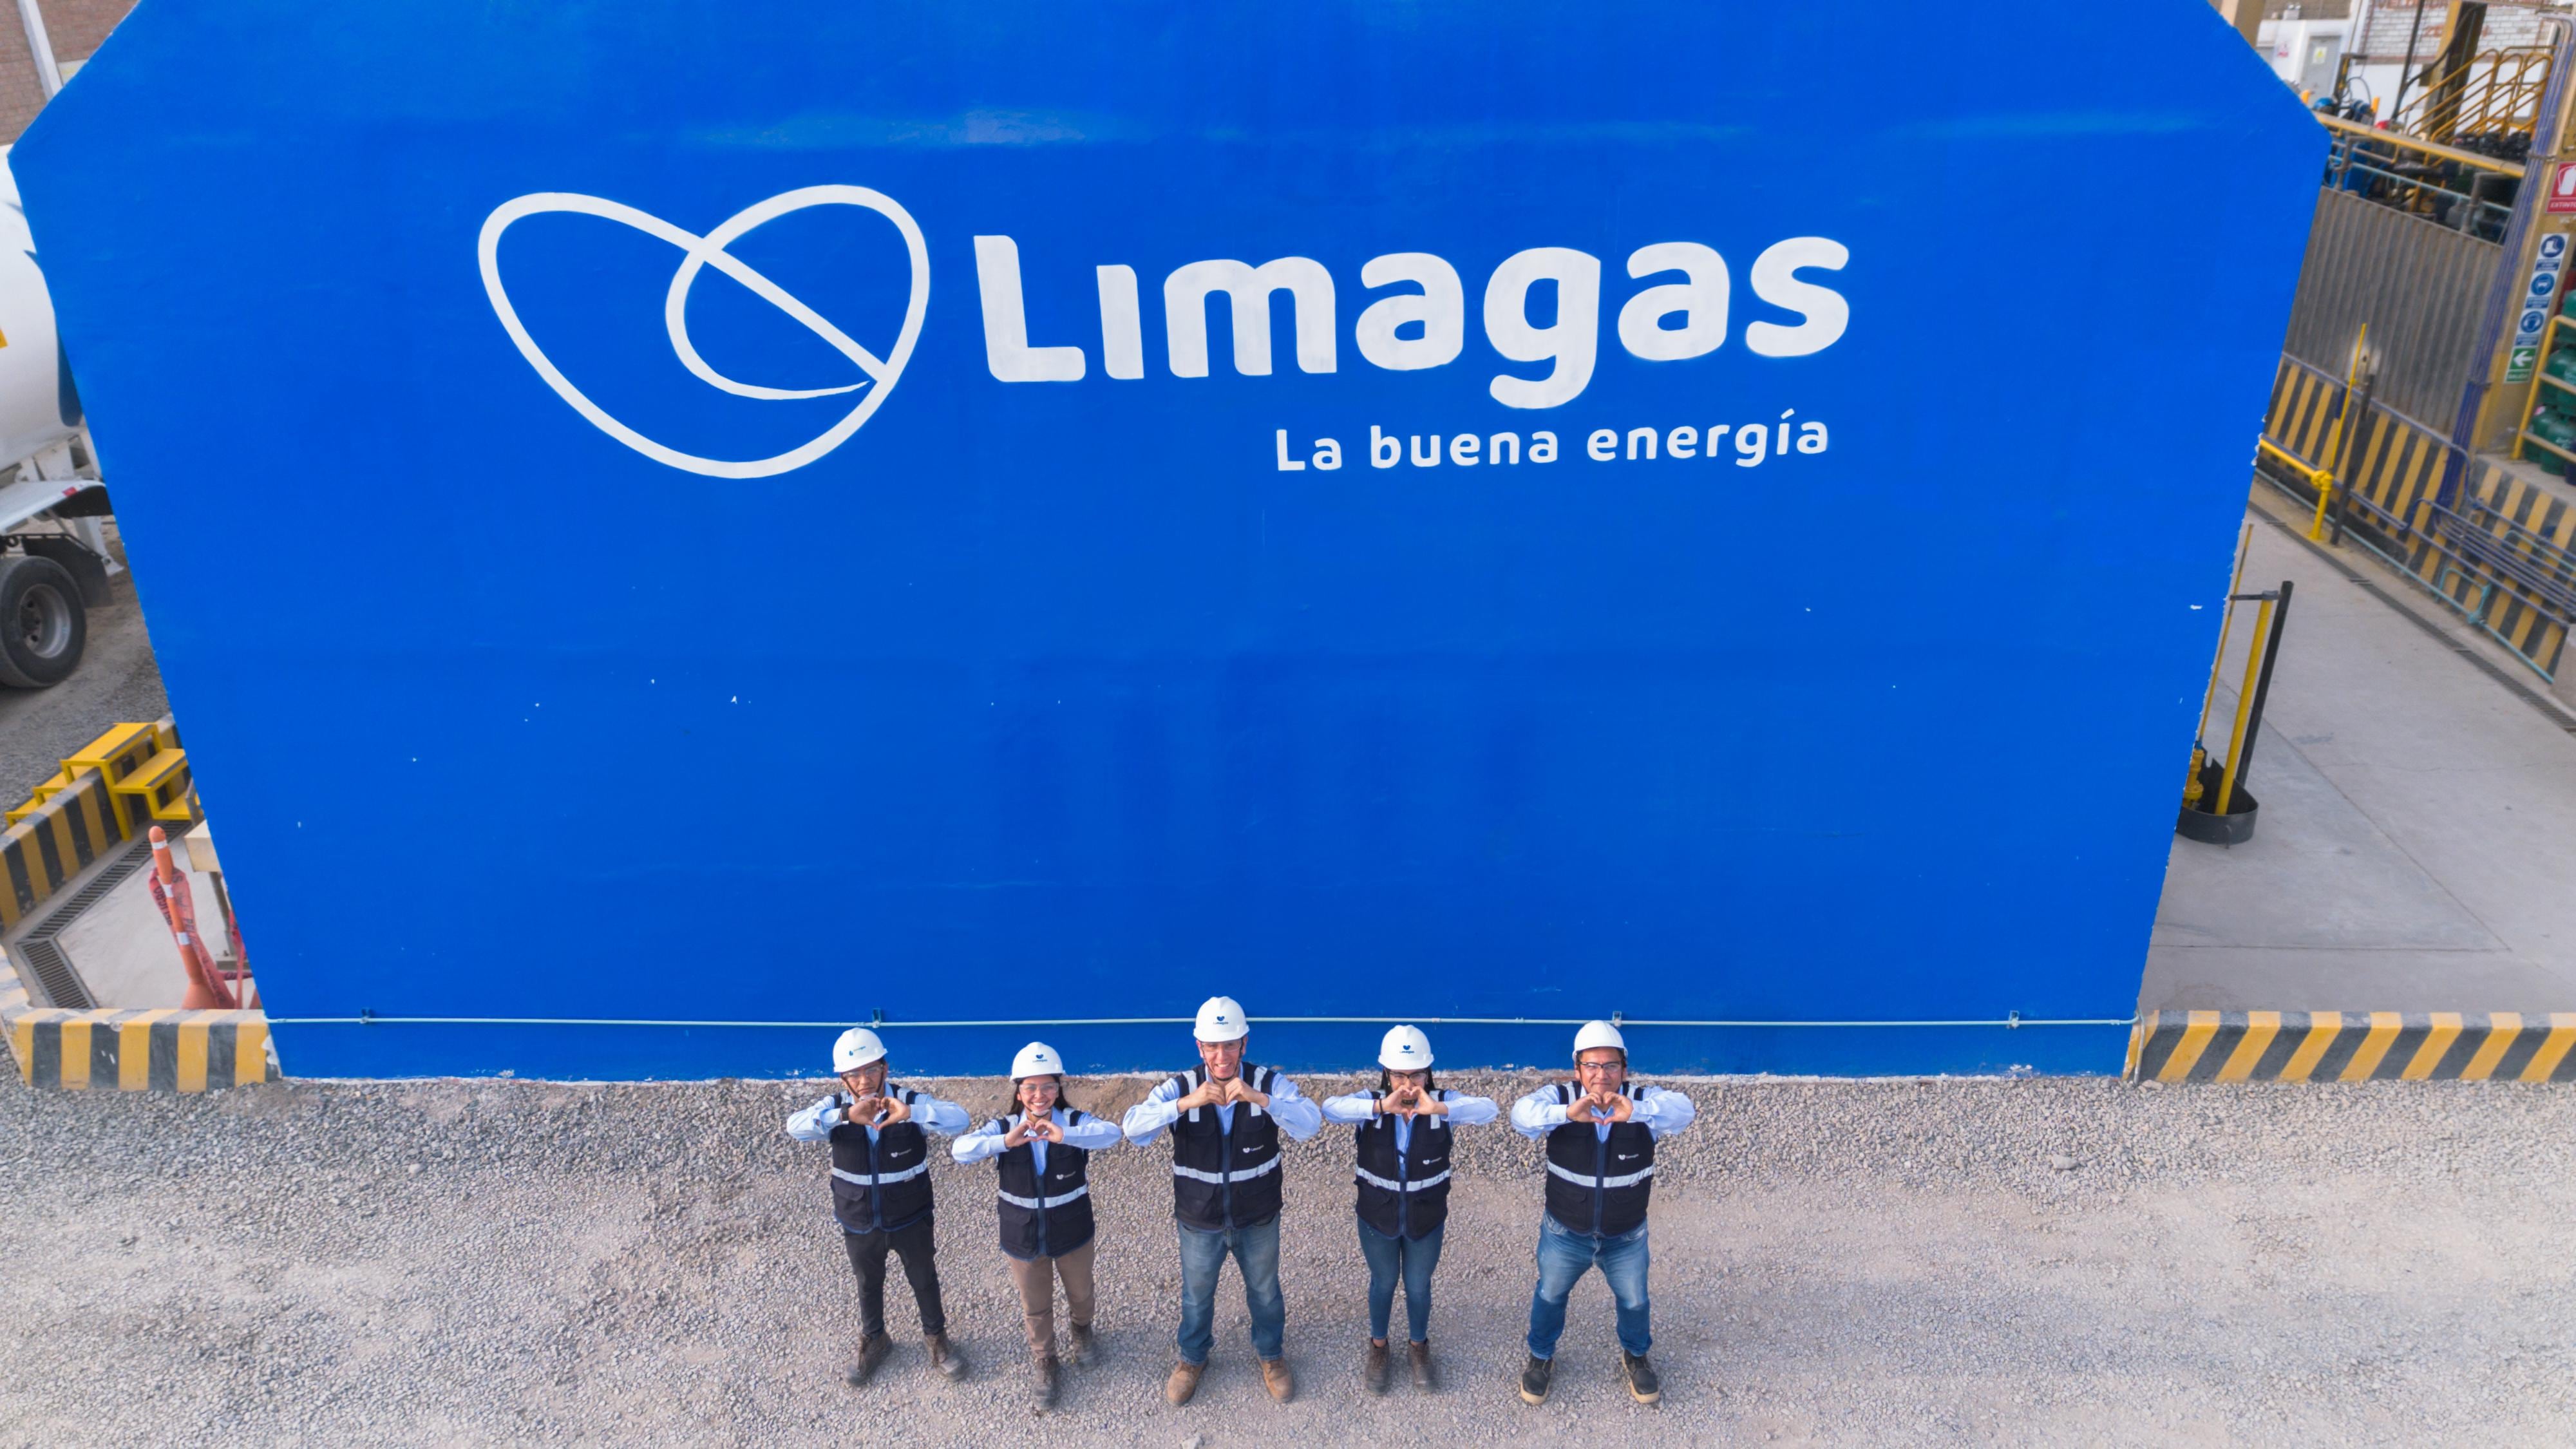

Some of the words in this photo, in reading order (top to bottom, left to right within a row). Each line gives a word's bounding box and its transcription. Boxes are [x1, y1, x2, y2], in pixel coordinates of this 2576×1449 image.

[974, 236, 1849, 409] Limagas
[1277, 430, 1341, 471] La
[1370, 426, 1557, 469] buena
[1587, 409, 1827, 468] energía
